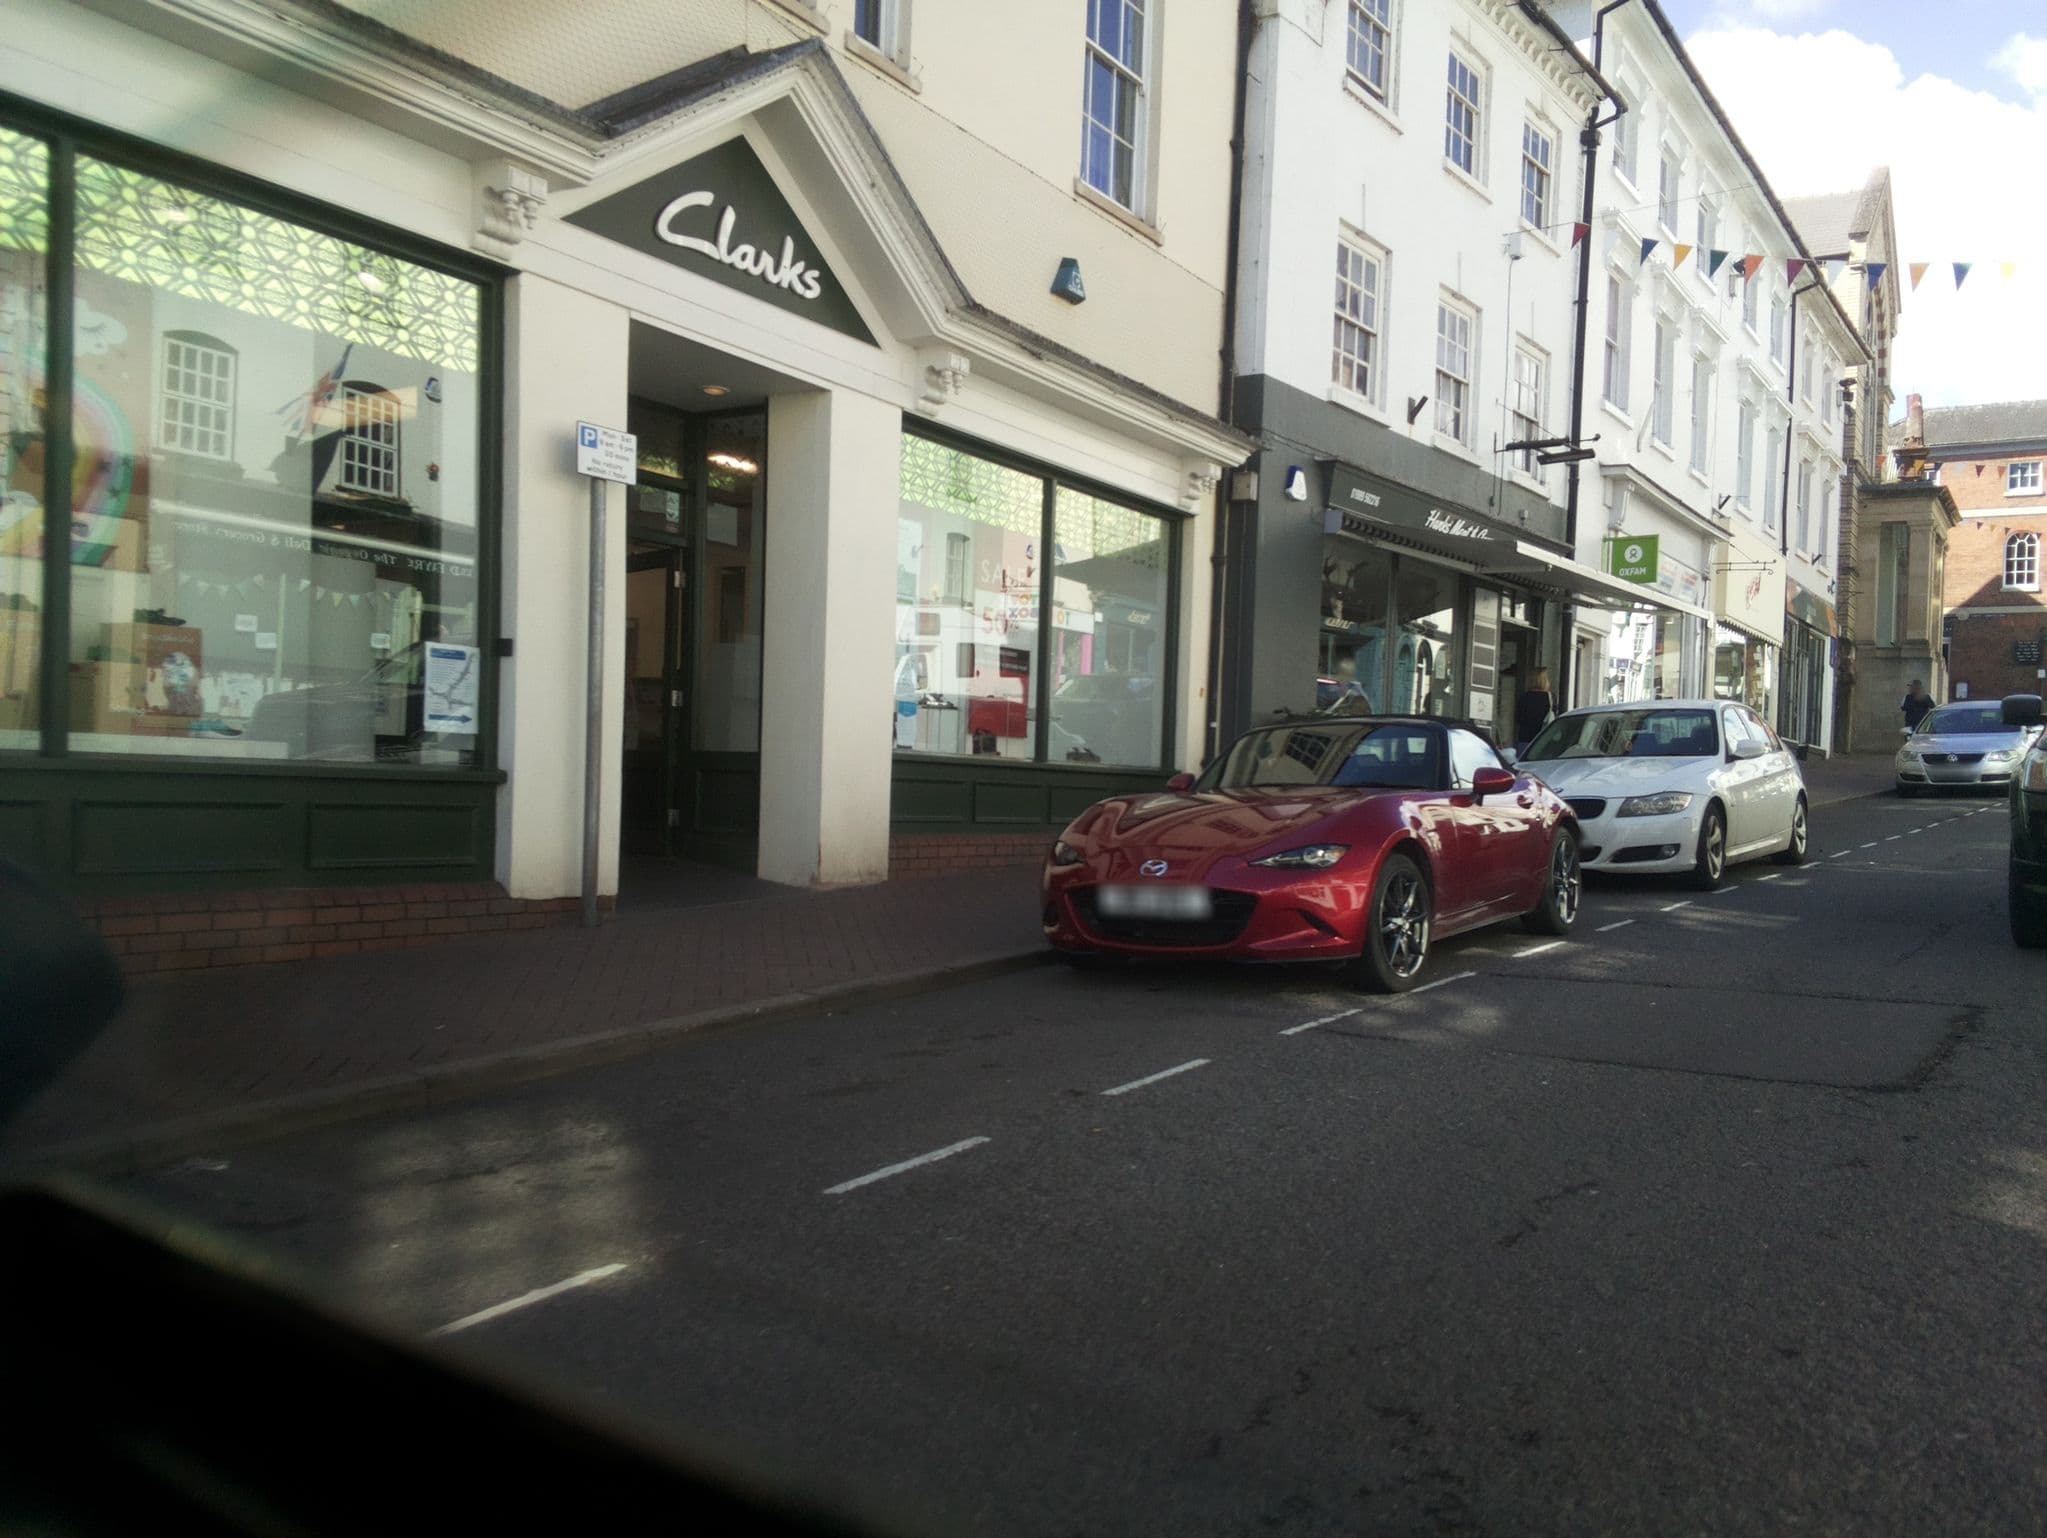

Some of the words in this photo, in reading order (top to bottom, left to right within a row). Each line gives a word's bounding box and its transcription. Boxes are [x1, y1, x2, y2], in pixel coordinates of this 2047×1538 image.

[657, 190, 821, 299] Clarks
[583, 428, 596, 446] P
[1619, 567, 1647, 577] OXFAM
